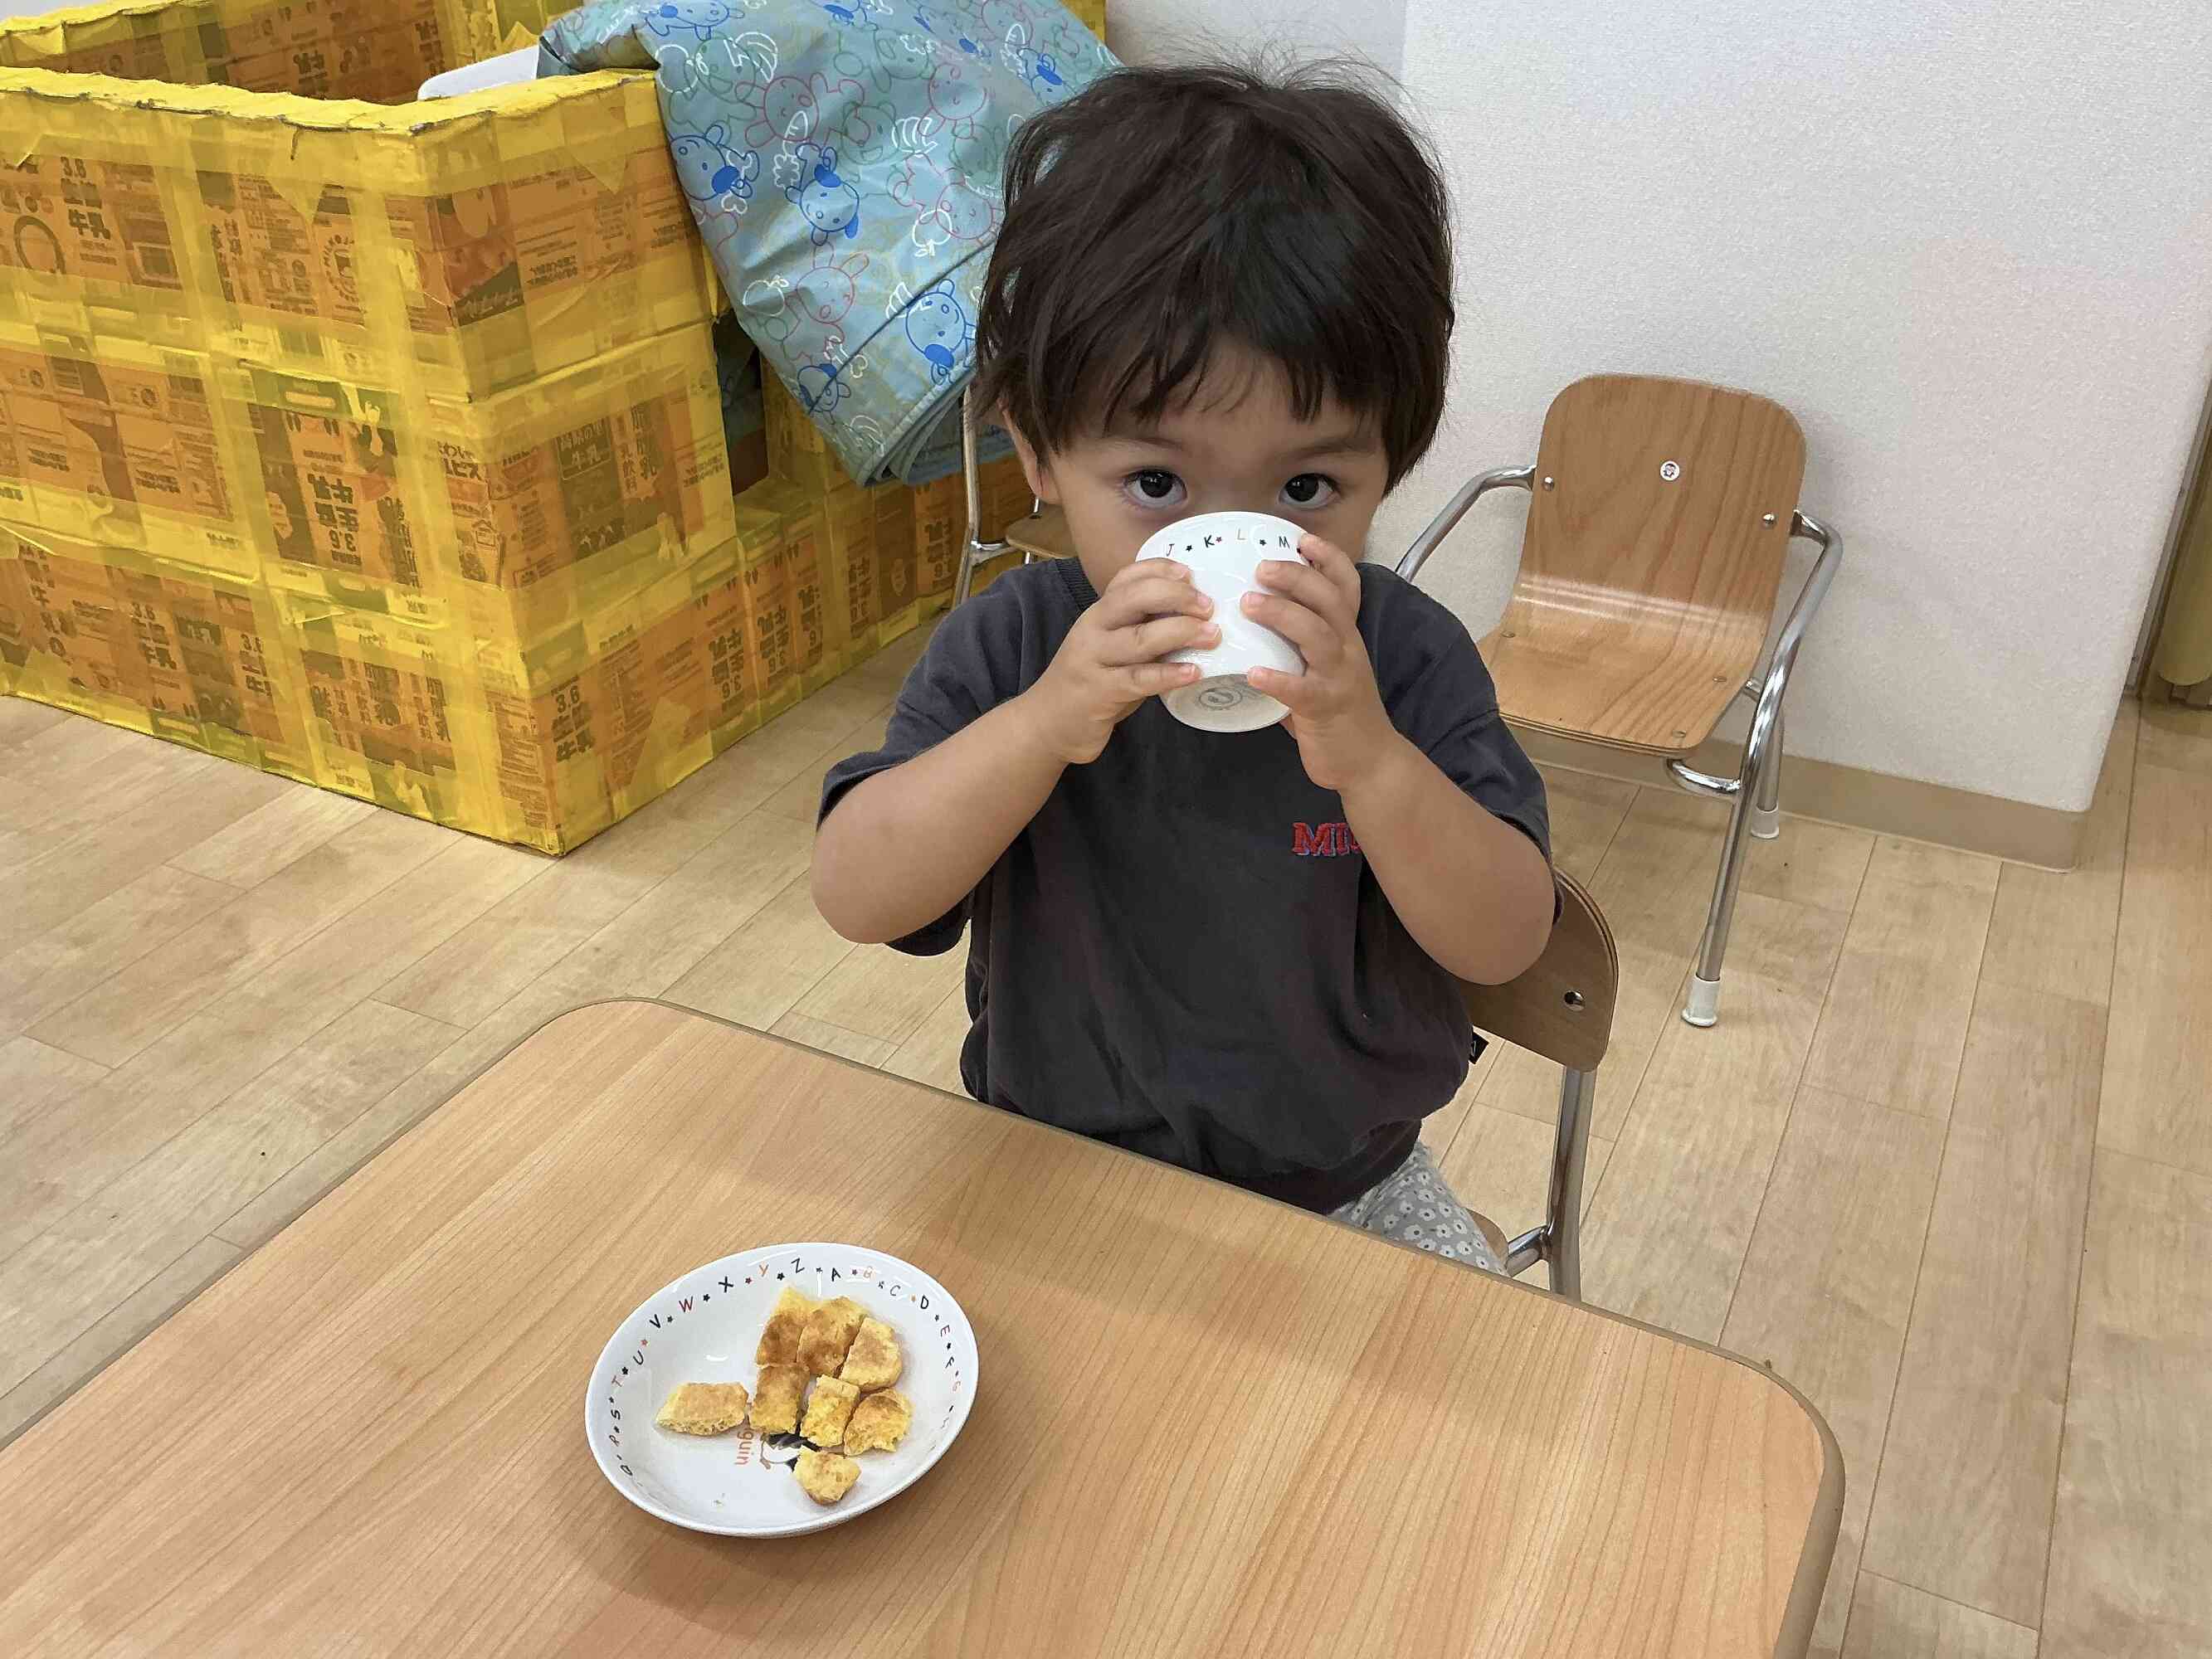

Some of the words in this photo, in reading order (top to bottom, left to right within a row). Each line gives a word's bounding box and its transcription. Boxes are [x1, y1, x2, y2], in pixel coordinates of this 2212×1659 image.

[1203, 534, 1216, 548] K
[1236, 528, 1246, 541] L
[1279, 536, 1291, 549] M
[1292, 822, 1361, 856] MI
[758, 1263, 769, 1277] Y
[791, 1258, 805, 1273] Z
[831, 1267, 841, 1282] A
[718, 1276, 734, 1293] X
[889, 1284, 901, 1297] C
[678, 1296, 694, 1313] W
[920, 1294, 929, 1310] D
[649, 1313, 661, 1329] V
[940, 1324, 951, 1337] E
[632, 1350, 645, 1365] U
[945, 1355, 955, 1369] F
[610, 1409, 621, 1420] S
[734, 1409, 754, 1466] guin
